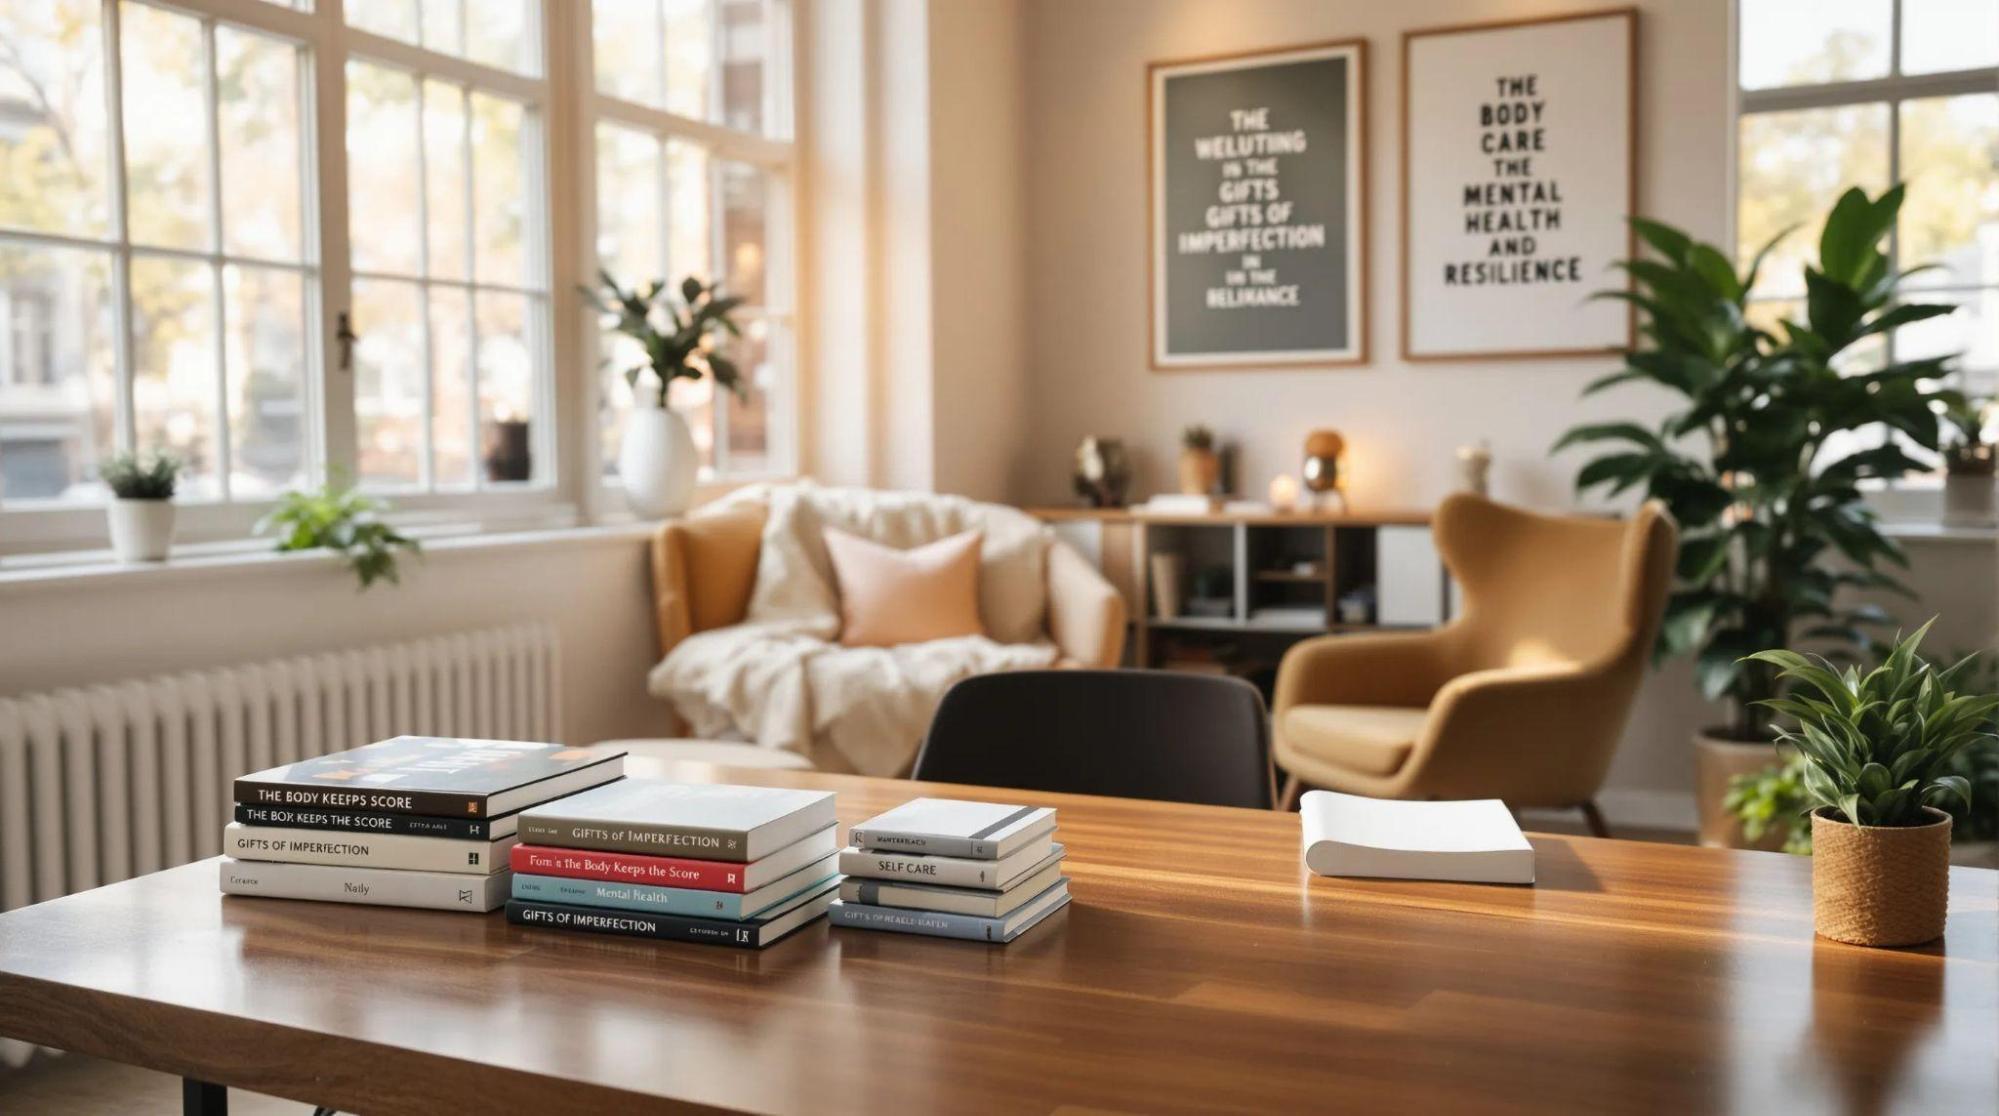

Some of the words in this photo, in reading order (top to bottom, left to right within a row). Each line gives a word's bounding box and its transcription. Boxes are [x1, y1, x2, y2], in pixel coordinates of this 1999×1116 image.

[1497, 75, 1537, 97] THE
[1230, 108, 1269, 131] THE
[1481, 101, 1545, 126] BODY
[1481, 129, 1545, 154] CARE
[1246, 157, 1278, 175] THE
[1493, 157, 1531, 177] THE
[1219, 177, 1280, 203] GIFTS
[1464, 181, 1562, 206] MENTAL
[1206, 203, 1263, 228] GIFTS
[1266, 201, 1293, 224] OF
[1466, 208, 1560, 233] HEALTH
[1178, 224, 1325, 254] IMPERFECTION
[1489, 236, 1537, 256] AND
[1445, 257, 1581, 285] RESILIENCE
[258, 789, 281, 802] THE
[286, 791, 318, 805] BODY
[371, 795, 413, 809] SCORE
[247, 809, 267, 821] THE
[297, 813, 328, 825] KEEPS
[330, 815, 351, 826] THE
[354, 816, 393, 829] SCORE
[237, 838, 269, 850] GIFTS
[272, 840, 288, 851] OF
[628, 830, 720, 848] IMPERFECTION
[564, 858, 581, 870] the
[584, 859, 611, 874] Body
[614, 863, 646, 878] Keeps
[649, 864, 666, 877] the
[669, 868, 700, 881] Score
[879, 861, 904, 873] SELF
[906, 863, 937, 876] CARE
[596, 887, 631, 900] Mental
[633, 889, 668, 903] Health
[522, 909, 553, 922] GIFTS
[557, 912, 570, 924] OF
[573, 914, 656, 933] IMPERFECTION
